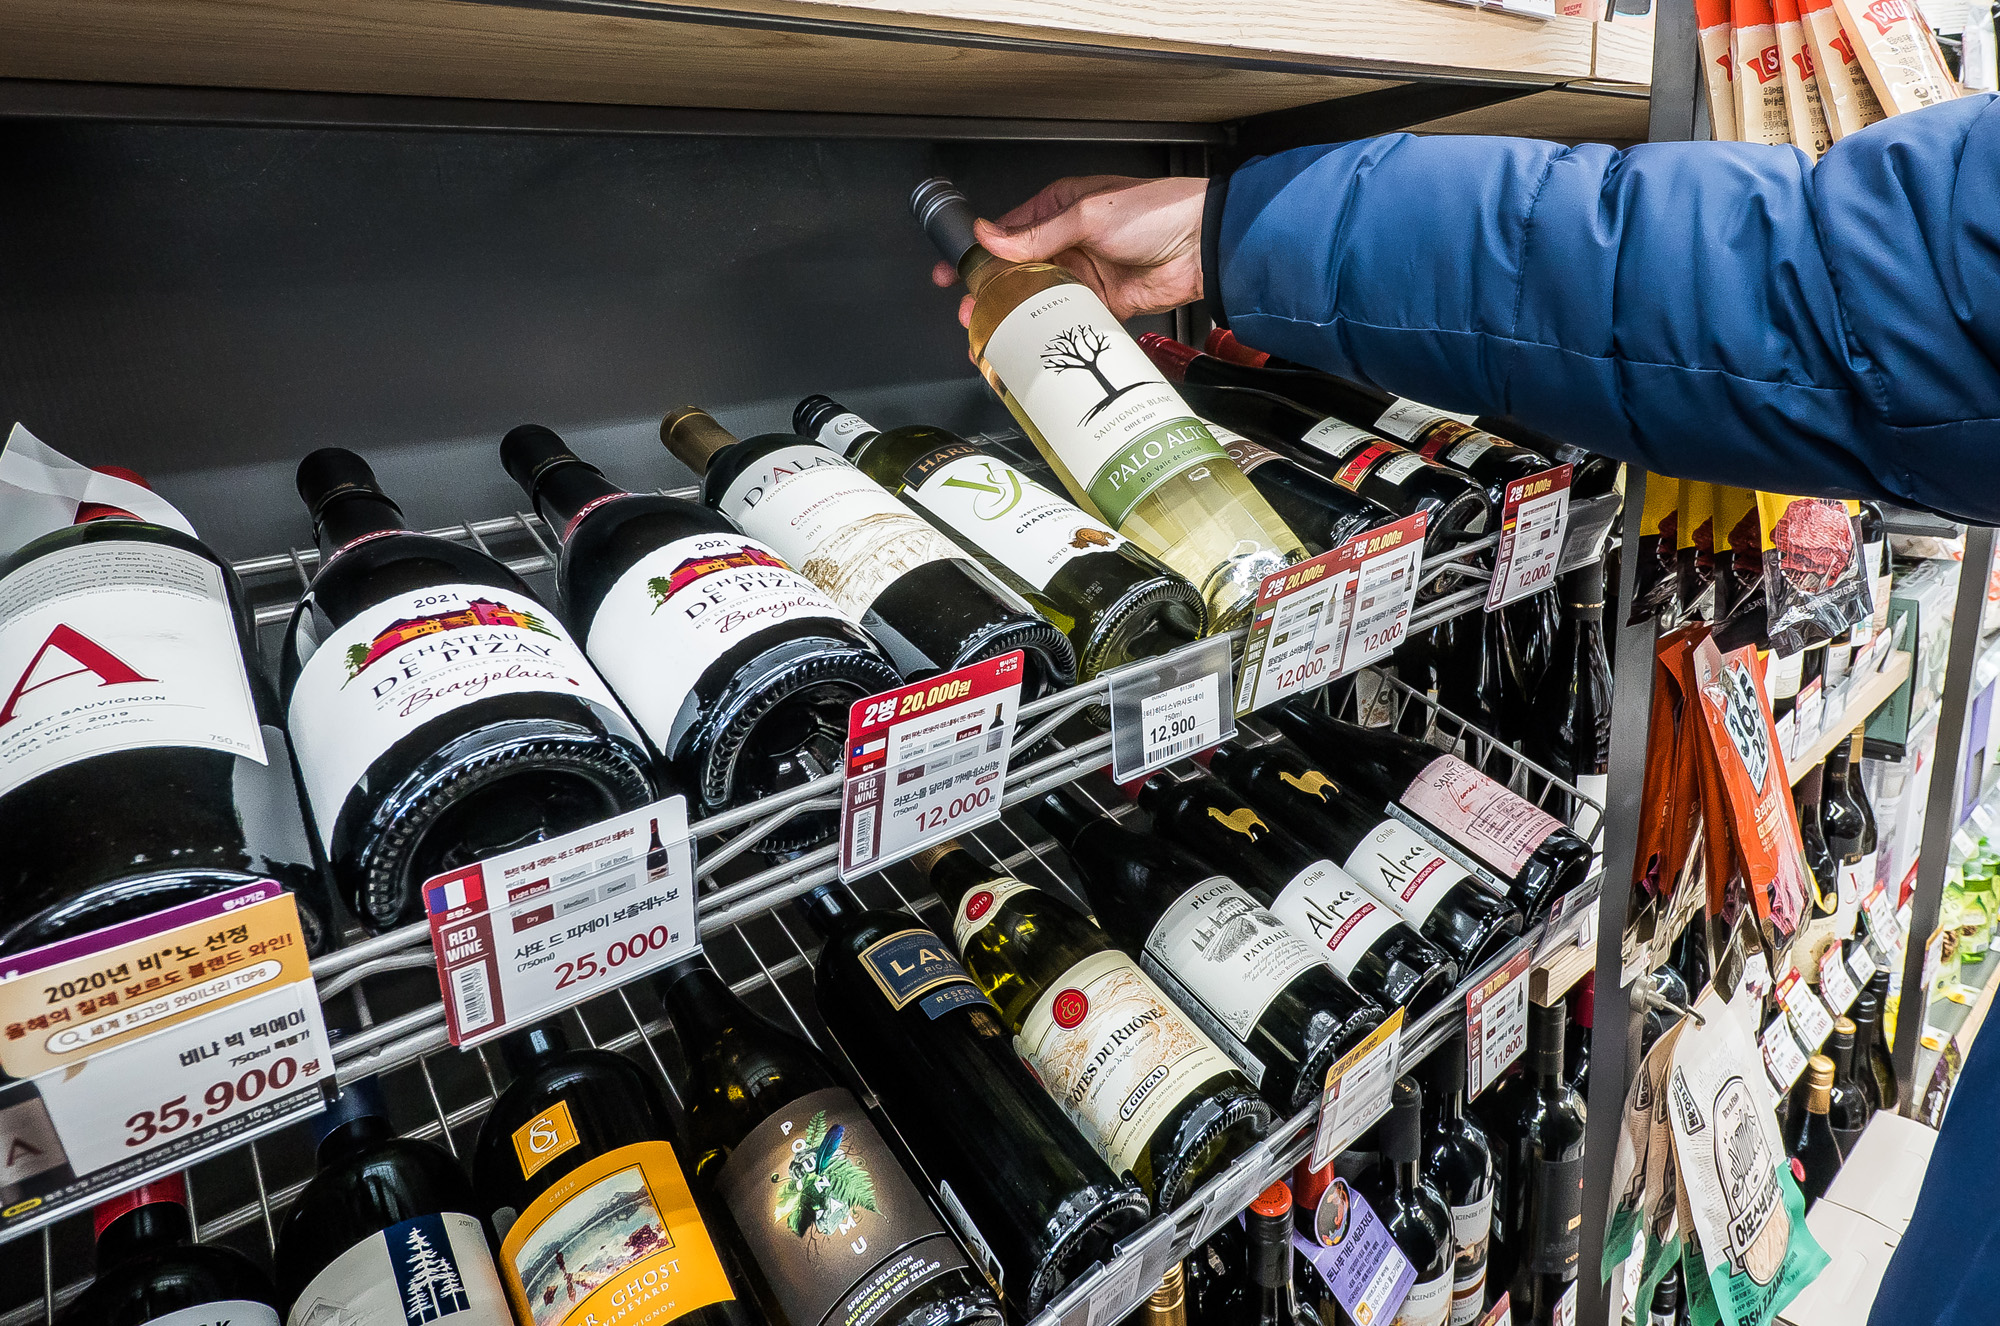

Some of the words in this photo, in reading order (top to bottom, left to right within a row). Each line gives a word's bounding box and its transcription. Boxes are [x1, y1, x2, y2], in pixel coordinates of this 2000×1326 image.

[1030, 296, 1071, 320] RESERVA
[1093, 403, 1146, 442] SAUVIGNON
[1147, 395, 1173, 408] BLANC
[1123, 419, 1142, 433] CHILE
[1142, 411, 1157, 424] 2021
[1106, 442, 1164, 491] PALO
[1166, 424, 1211, 450] ALTO
[1139, 471, 1154, 485] D.O.
[1153, 459, 1172, 474] Valle
[1172, 454, 1181, 464] de
[1509, 484, 1523, 503] 2병
[790, 495, 835, 527] CABERNET
[695, 539, 731, 552] 2021
[805, 524, 823, 541] 2019
[1368, 530, 1404, 554] 20,000원
[1047, 546, 1068, 566] ESTD
[1264, 580, 1287, 600] 2병
[1285, 563, 1327, 591] 20,000원
[413, 592, 460, 609] 2021
[683, 592, 727, 621] DE
[399, 632, 519, 667] CHÂTEAU
[371, 663, 423, 699] DE
[443, 642, 556, 664] PIZAY
[420, 659, 489, 686] BOUTEILLE
[397, 665, 558, 718] Beaujolais
[861, 697, 898, 728] 2병
[898, 679, 972, 717] 20,000원
[1, 716, 54, 745] ERNET
[61, 695, 166, 716] SAUVIGNON
[44, 724, 71, 737] VIK
[88, 711, 129, 723] 2019
[1150, 715, 1196, 744] 12,900
[209, 734, 233, 746] 750
[854, 789, 878, 805] WINE
[857, 778, 877, 793] RED
[1376, 826, 1396, 844] Chile
[1303, 868, 1326, 888] Chile
[1377, 845, 1425, 892] Alpaca
[511, 888, 529, 901] Light
[529, 883, 548, 896] Body
[606, 881, 627, 895] Sweet
[563, 895, 590, 911] Medium
[969, 895, 988, 916] 2019
[1303, 888, 1355, 940] Alpaca
[513, 939, 546, 960] 샤또
[549, 933, 564, 947] 드
[566, 914, 609, 940] 피제이
[612, 887, 681, 925] 보졸레누보
[526, 913, 539, 926] Dry
[448, 926, 478, 947] RED
[1242, 930, 1292, 962] PATRIALE
[44, 962, 129, 1004] 2020년
[204, 924, 250, 951] 선정
[446, 940, 483, 963] WINE
[516, 951, 556, 973] (750ml)
[552, 924, 680, 990] 25,000원
[124, 970, 184, 1001] 보르도
[249, 932, 295, 957] 와인!
[1097, 1044, 1114, 1067] DU
[1112, 1007, 1161, 1047] RHÔNE
[228, 1046, 271, 1068] 750ml
[125, 1056, 321, 1147] 35,900원
[247, 1105, 272, 1120] 10%
[549, 1180, 576, 1203] CHILE
[610, 1258, 682, 1308] GHOST
[845, 1286, 887, 1326] SAUVIGNON
[883, 1268, 909, 1291] BLANC
[907, 1257, 926, 1273] 2021
[847, 1279, 876, 1311] SPECIAL
[874, 1255, 914, 1286] SELECTION
[855, 1293, 892, 1326] BOROUGH
[892, 1278, 912, 1296] NEW
[910, 1260, 942, 1285] ZEALAND
[1406, 1290, 1437, 1302] RIGINES
